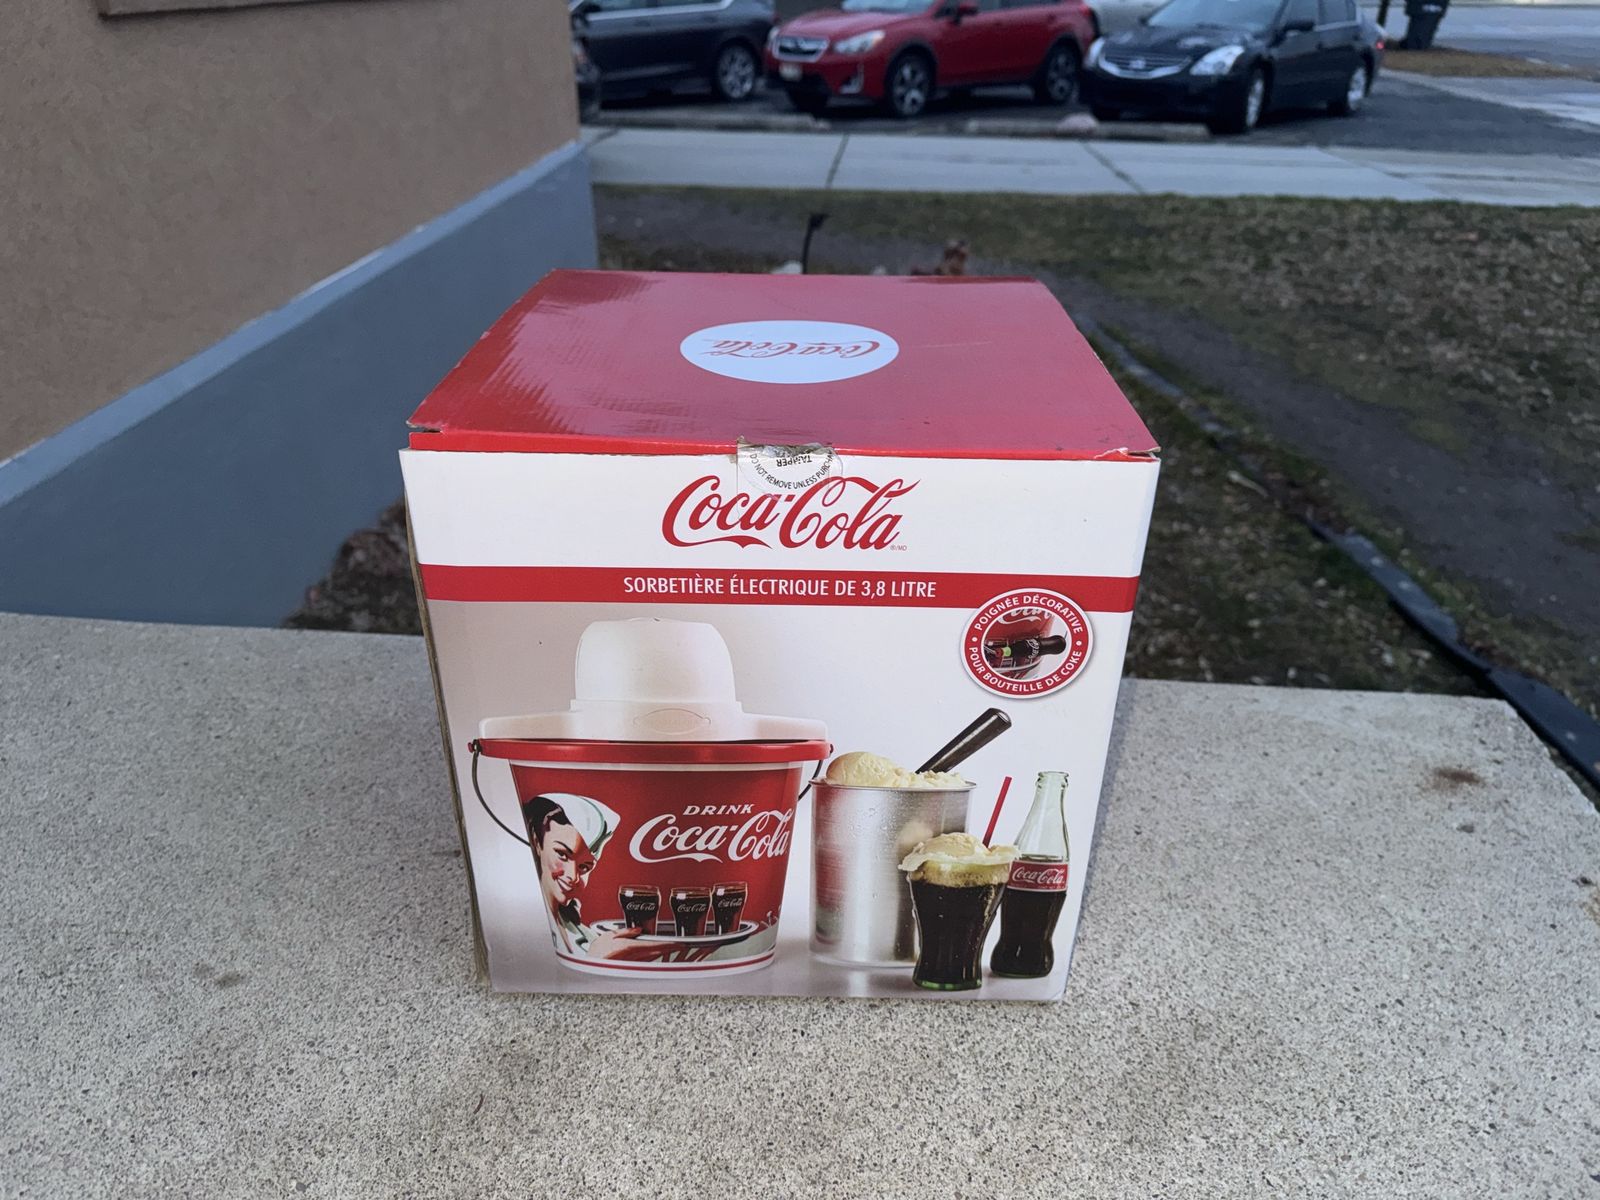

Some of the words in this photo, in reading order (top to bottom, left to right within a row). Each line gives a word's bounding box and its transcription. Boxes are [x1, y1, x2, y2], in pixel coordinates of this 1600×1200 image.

[701, 338, 880, 359] Coca-Cola
[755, 463, 767, 477] NOT
[766, 474, 792, 490] REMOVE
[793, 476, 818, 490] UNLESS
[662, 475, 921, 550] Coca-Cola
[623, 573, 724, 594] SORBETIÈRE
[729, 574, 829, 597] ÉLECTRIQUE
[834, 580, 856, 597] DE
[860, 580, 886, 599] 3,8
[891, 581, 937, 598] LITRE
[974, 596, 1020, 631] POIGNÉE
[1023, 594, 1083, 634] DÉCORATIVE
[969, 646, 986, 675] POUR
[983, 671, 1044, 692] BOUTEILLE
[1045, 674, 1061, 687] DE
[1061, 650, 1083, 676] COKE
[683, 803, 755, 816] DRINK
[629, 808, 794, 863] Coca-Cola
